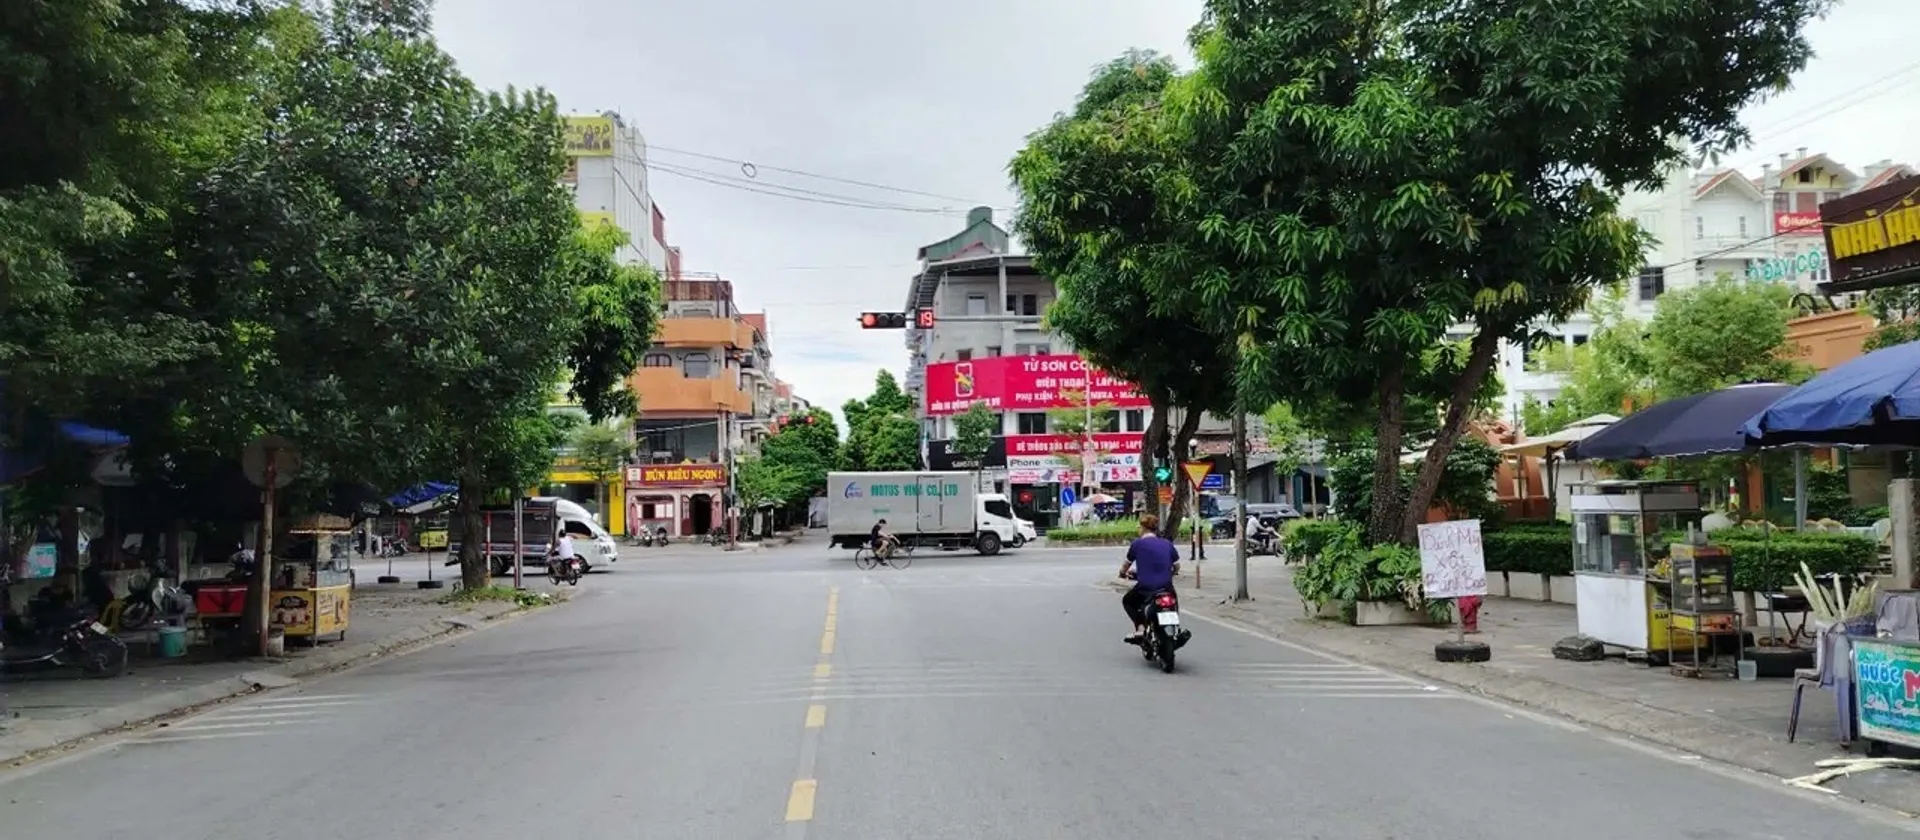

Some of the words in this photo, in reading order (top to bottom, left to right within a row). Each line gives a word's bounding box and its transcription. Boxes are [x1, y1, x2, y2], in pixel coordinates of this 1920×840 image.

[1831, 209, 1889, 260] NHÀ
[921, 311, 932, 326] 19
[1023, 358, 1038, 371] TỪ
[1041, 360, 1067, 371] SƠN
[871, 484, 899, 496] MOTUS
[944, 484, 958, 496] LTD
